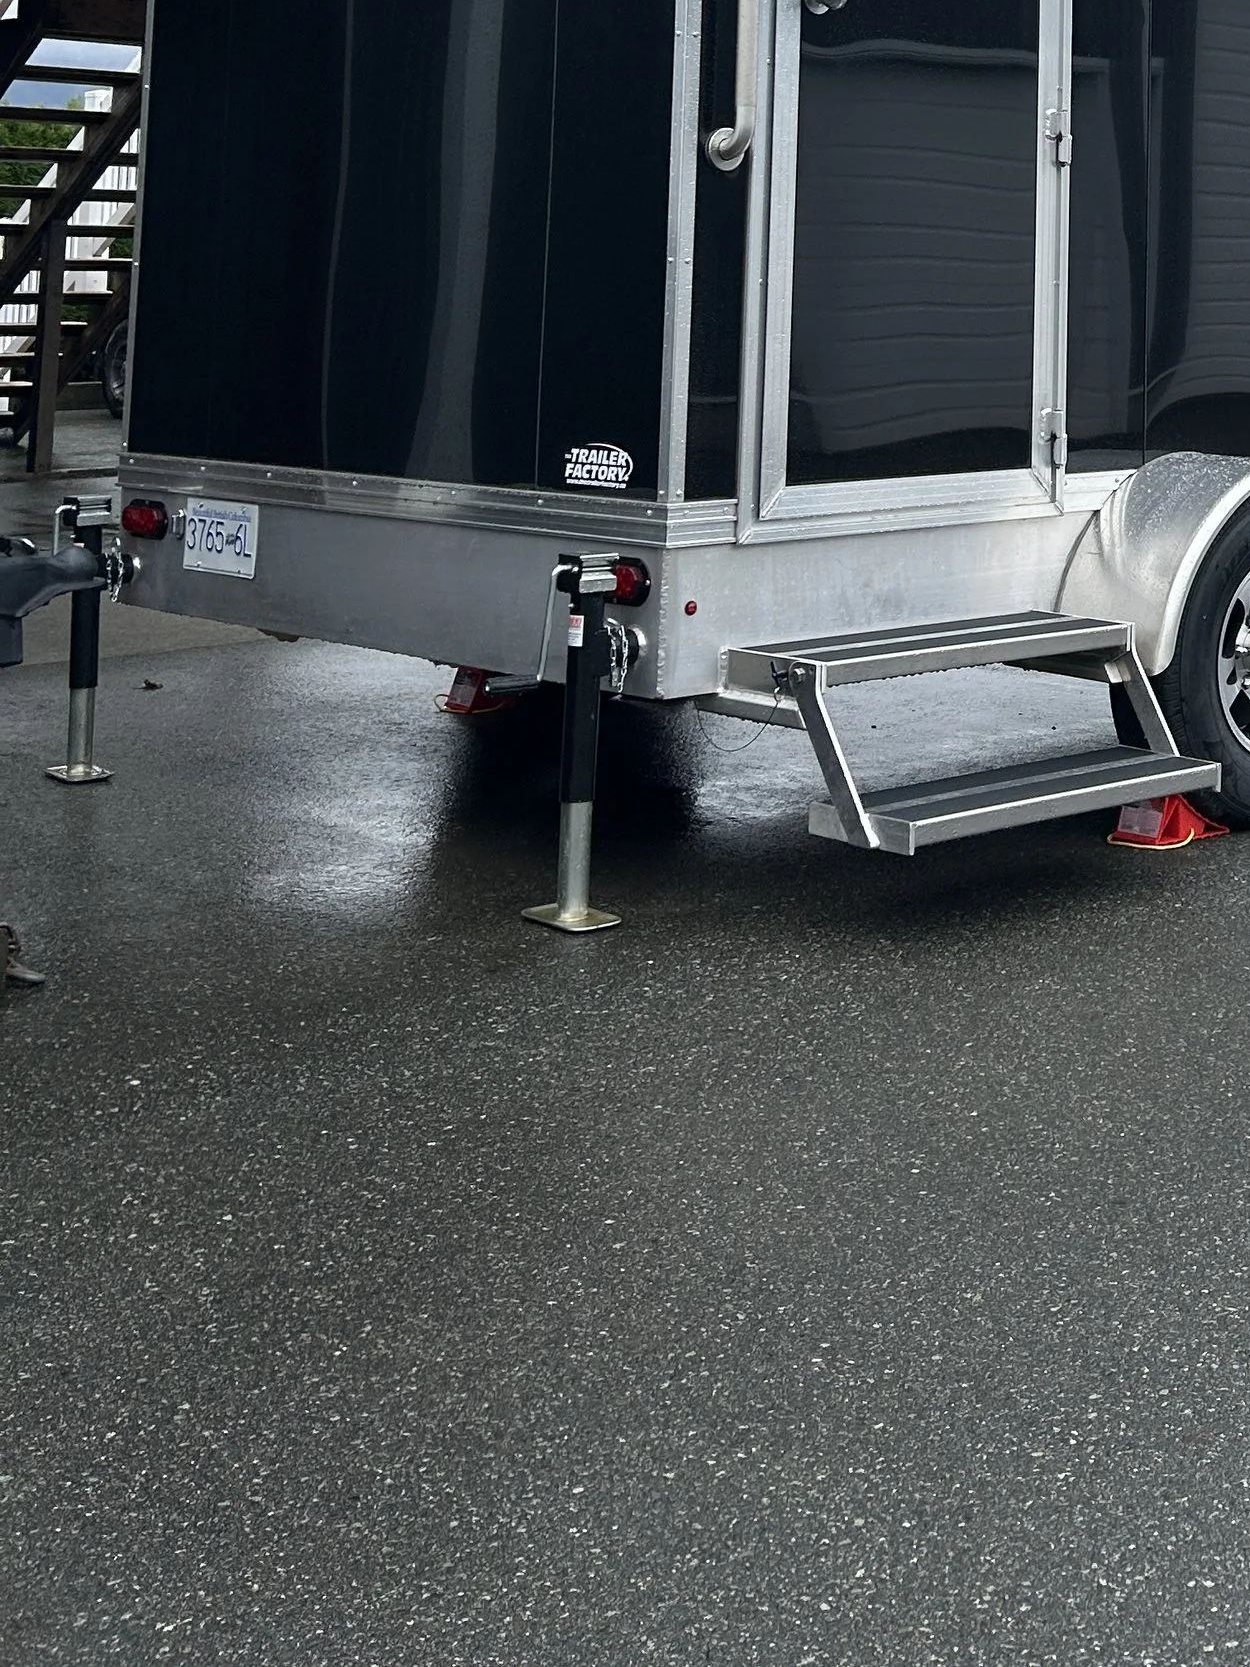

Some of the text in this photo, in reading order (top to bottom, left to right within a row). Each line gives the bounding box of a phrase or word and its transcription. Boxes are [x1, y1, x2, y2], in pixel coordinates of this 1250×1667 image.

[570, 447, 629, 467] TRAILER
[564, 463, 628, 482] FACTORY
[187, 517, 225, 554] 3765
